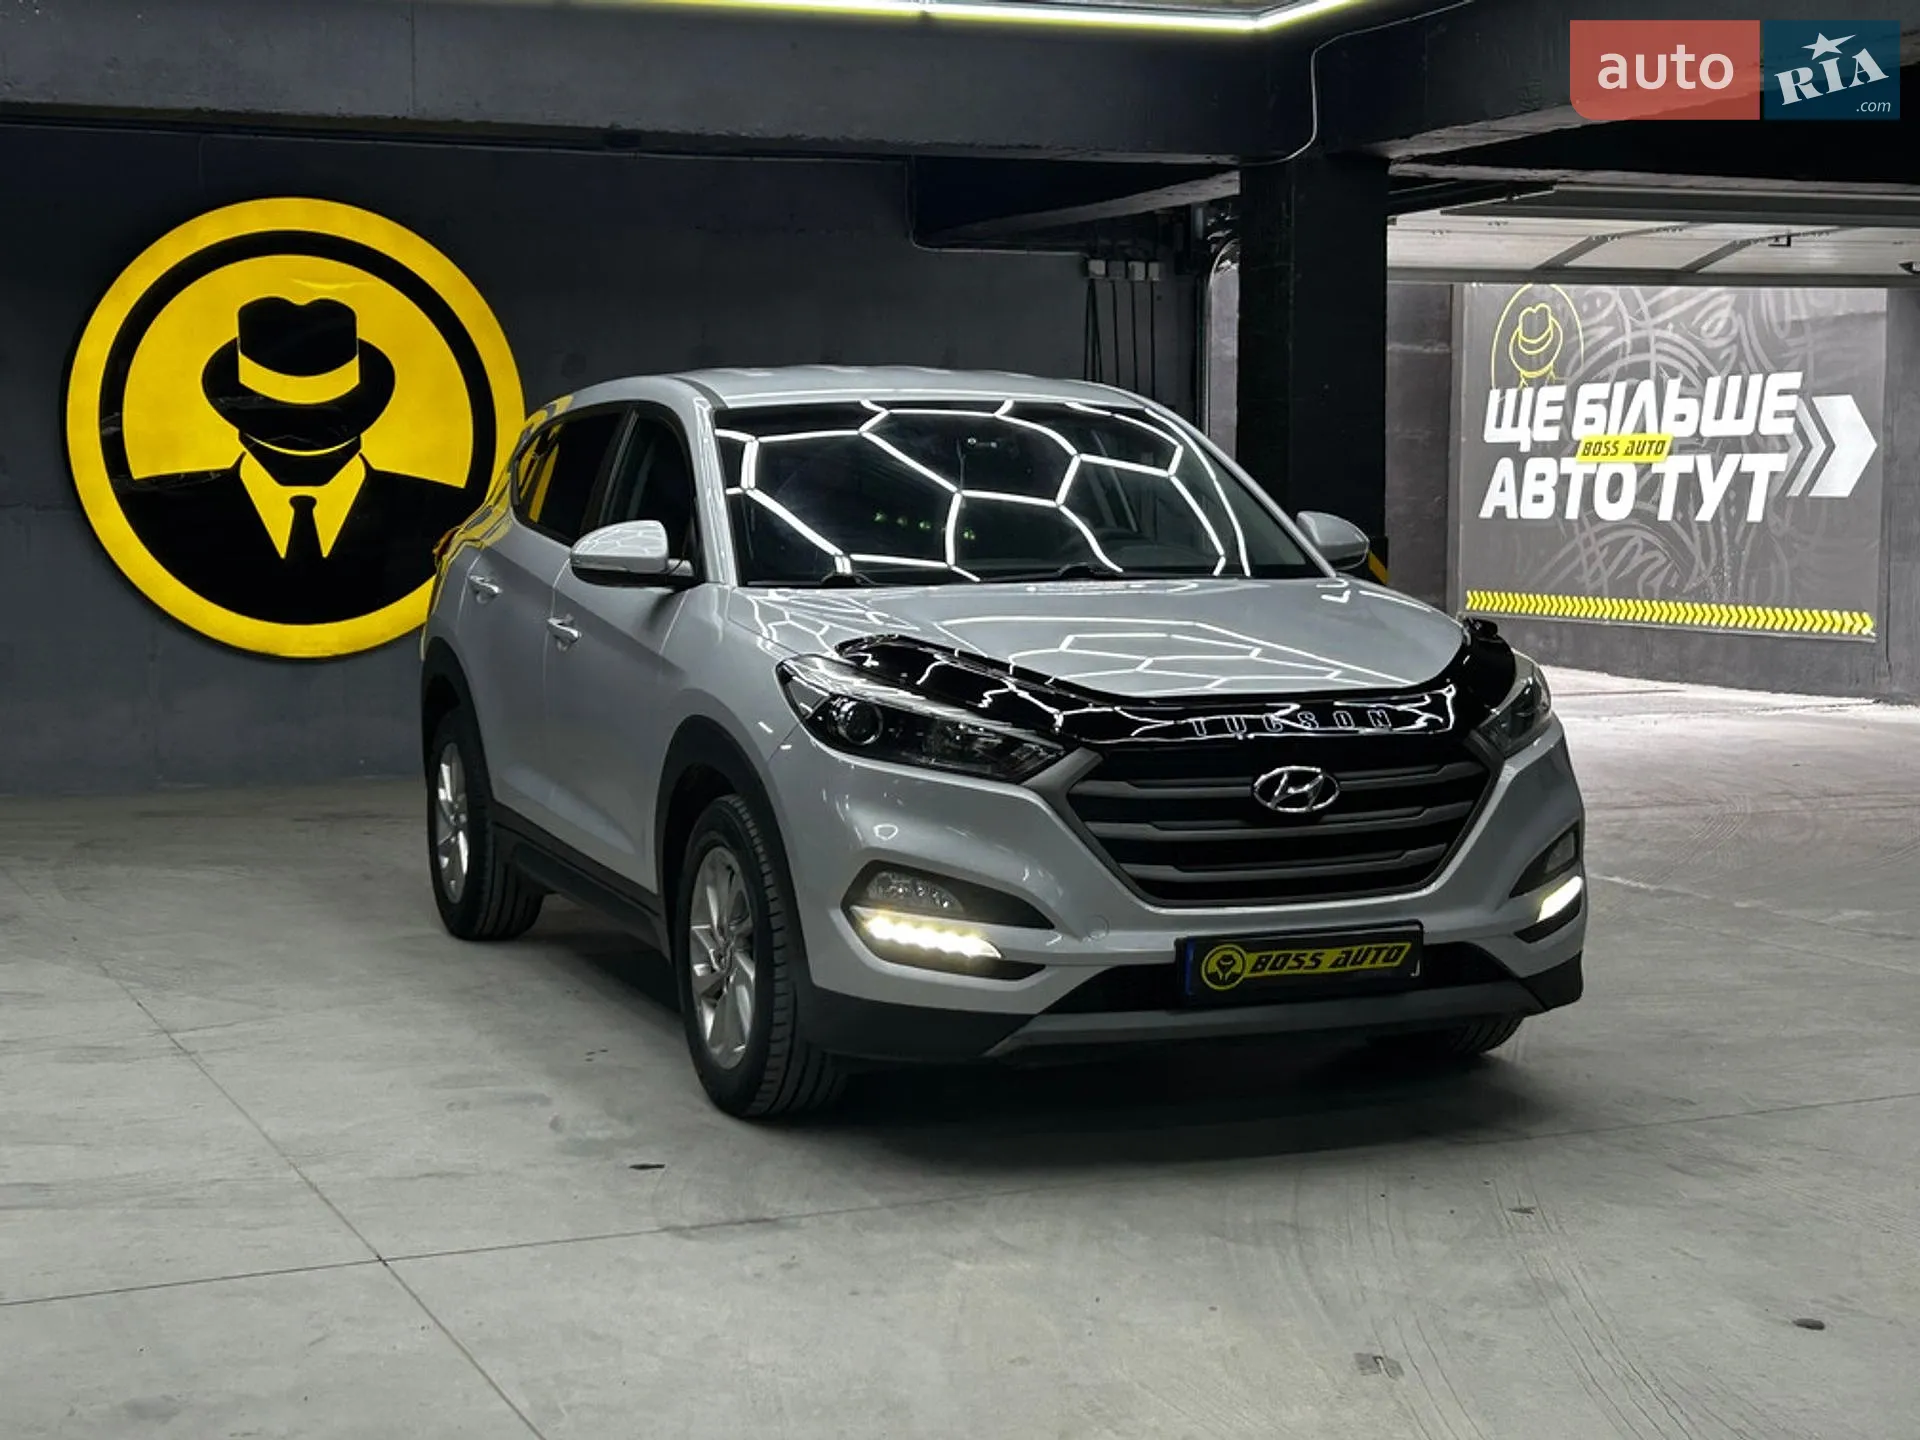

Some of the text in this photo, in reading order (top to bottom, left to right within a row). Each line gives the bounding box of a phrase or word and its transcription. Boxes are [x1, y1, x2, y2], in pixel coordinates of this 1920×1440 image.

[1483, 371, 1803, 452] ЩЕ БІЛЬШЕ
[1581, 440, 1667, 457] BOSS AUTO
[1479, 452, 1788, 523] АВТО ТУТ
[1191, 708, 1392, 738] TUCSON
[1250, 945, 1406, 973] BOSS AUTO
